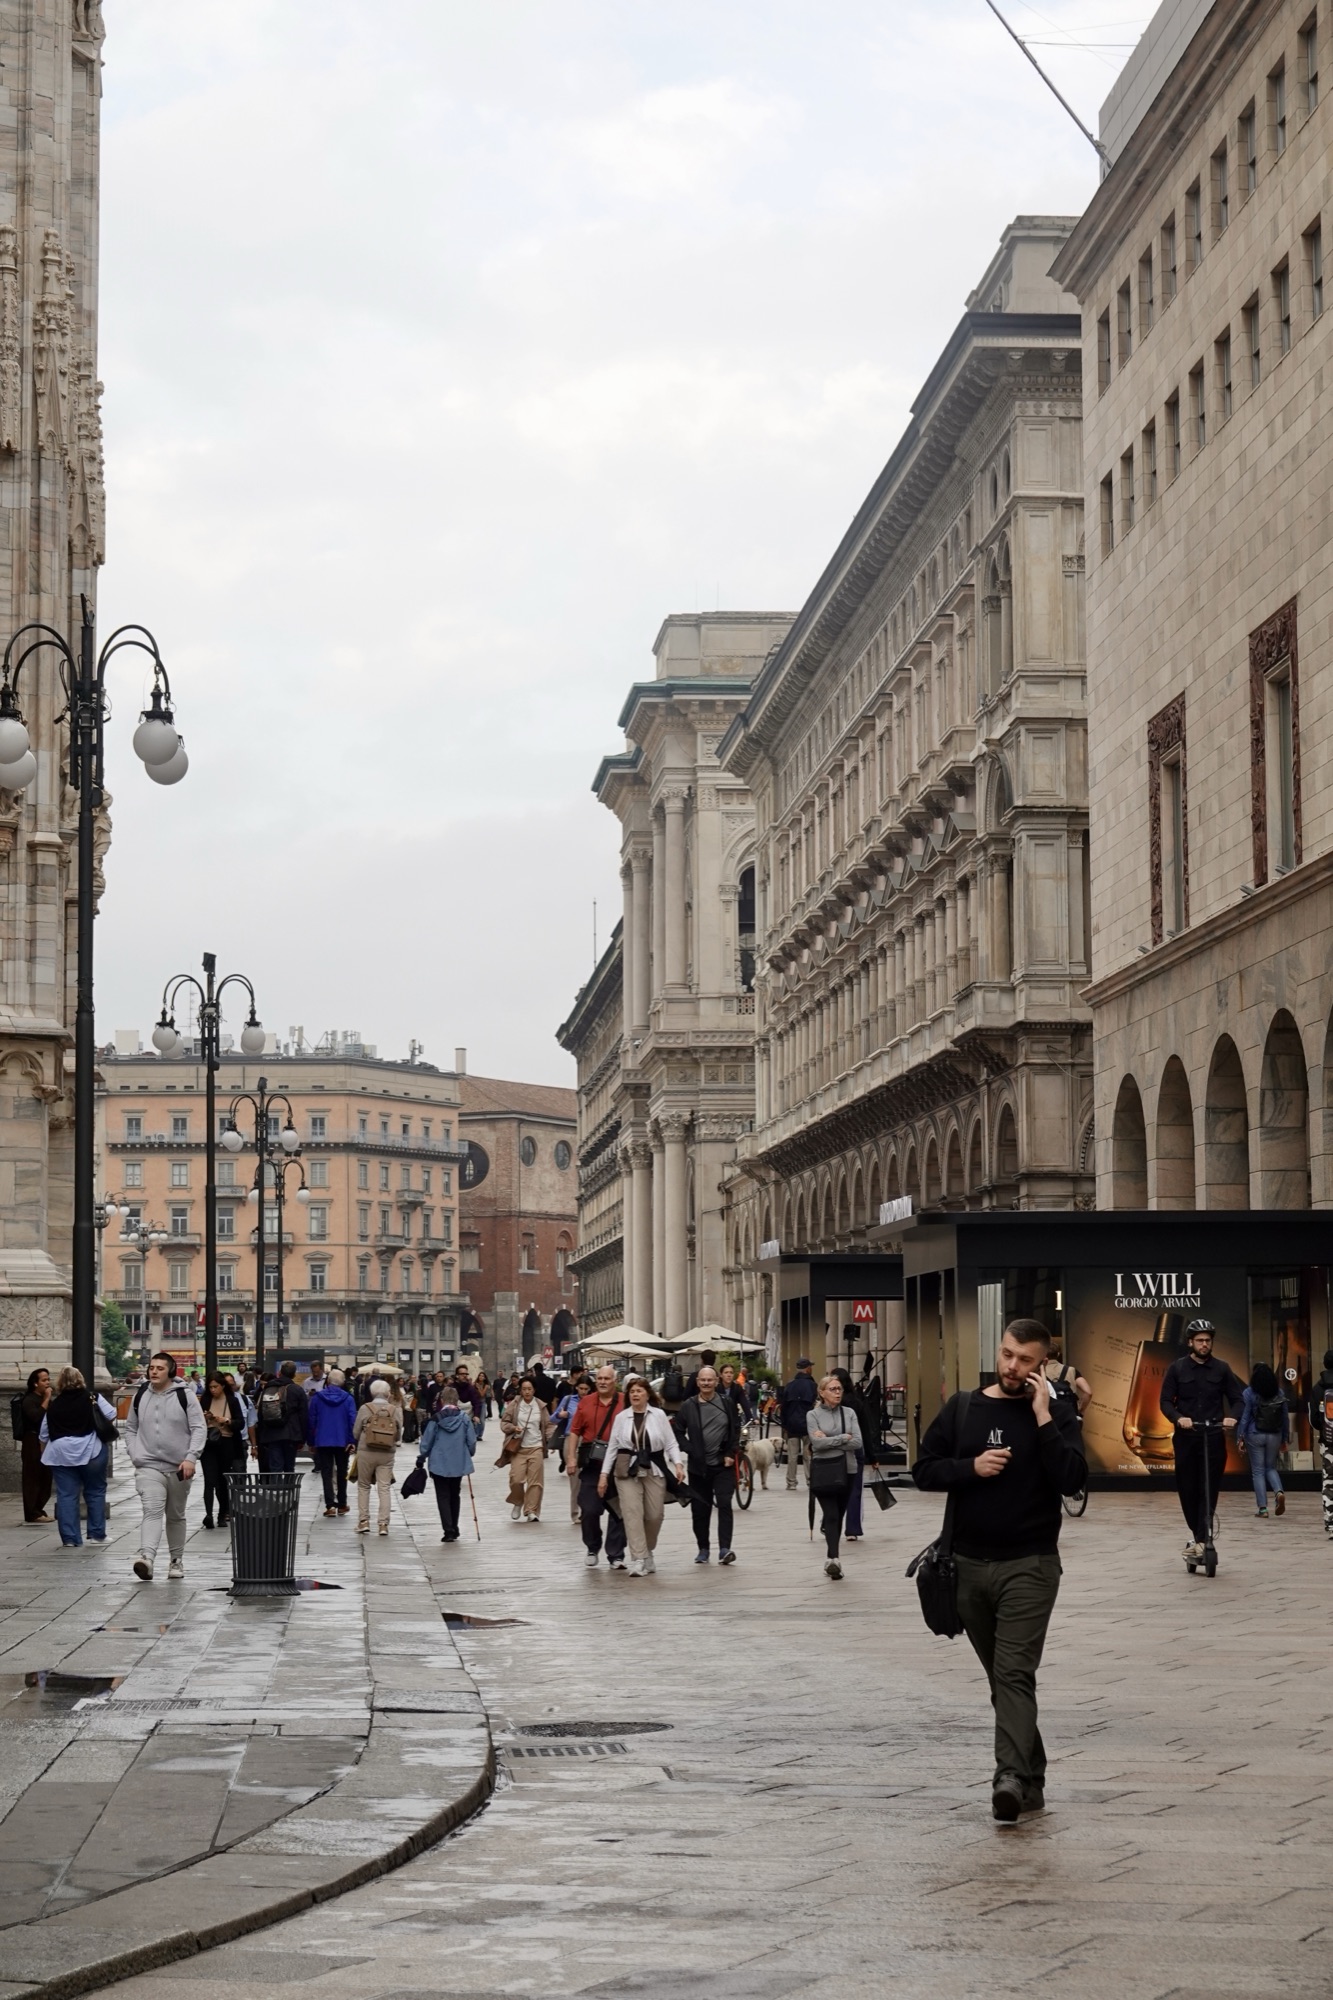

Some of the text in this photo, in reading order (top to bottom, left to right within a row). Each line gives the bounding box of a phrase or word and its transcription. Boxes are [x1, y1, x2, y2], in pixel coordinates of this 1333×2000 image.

[1114, 1273, 1200, 1297] I WILL
[1114, 1297, 1200, 1308] GIORGIO ARMANI
[855, 1304, 873, 1318] M
